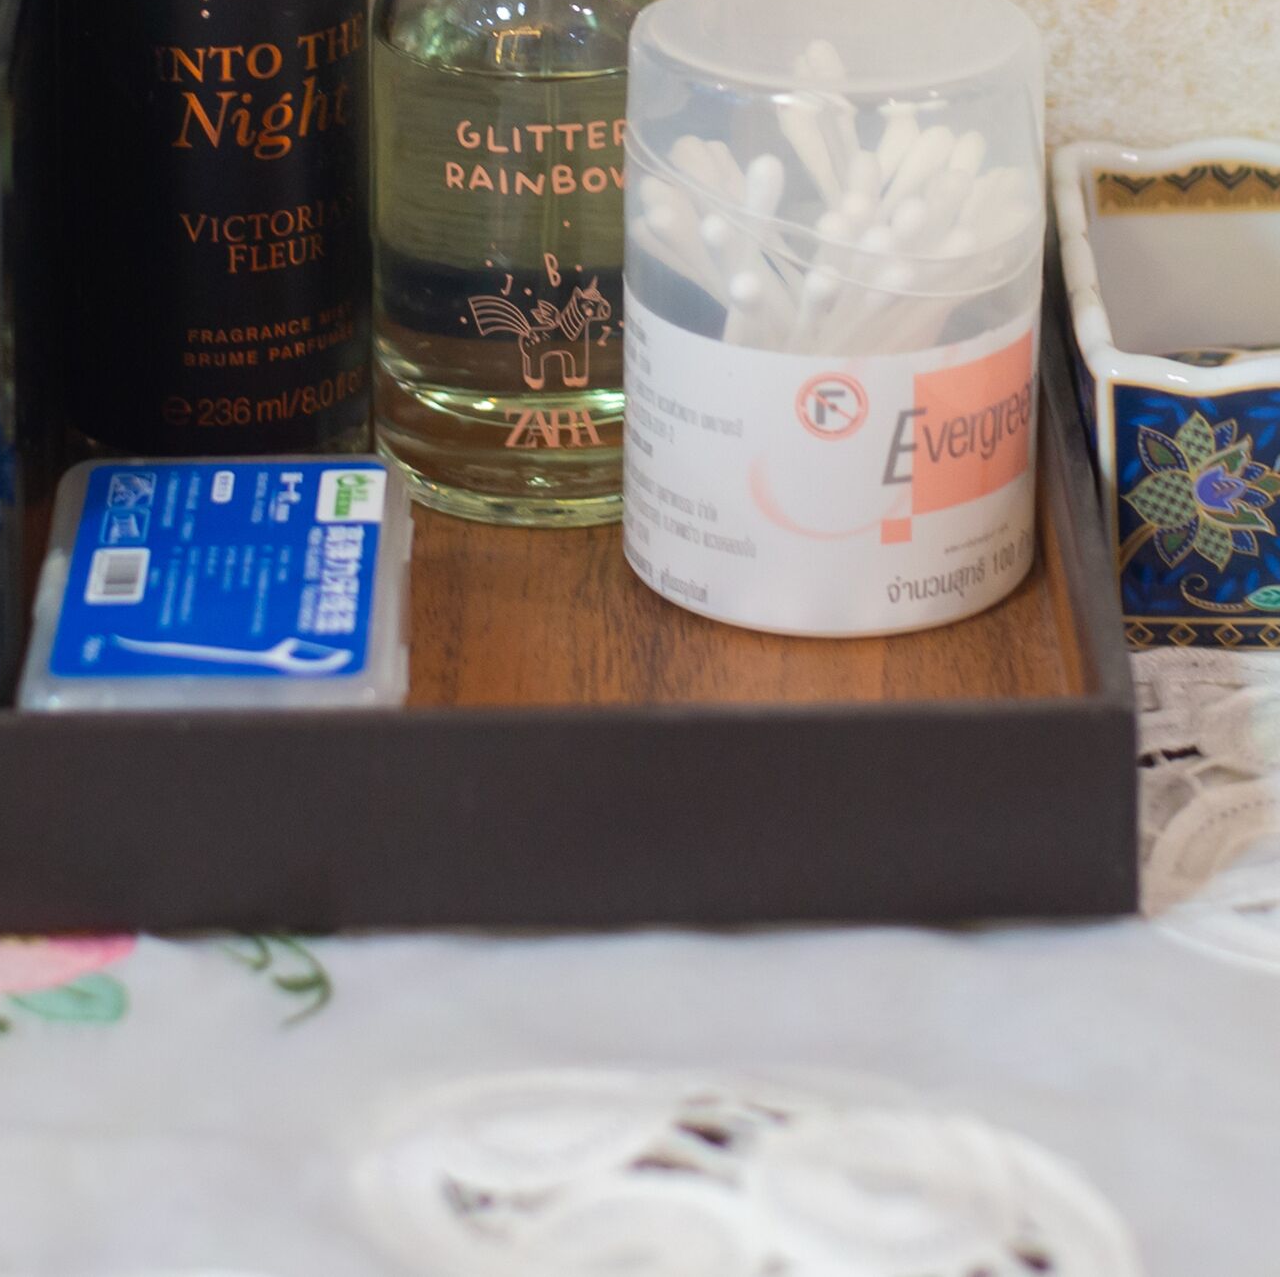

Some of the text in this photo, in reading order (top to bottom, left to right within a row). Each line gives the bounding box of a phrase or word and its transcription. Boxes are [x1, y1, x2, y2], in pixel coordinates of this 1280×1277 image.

[171, 75, 350, 161] Night
[227, 233, 325, 274] FLEUR
[186, 315, 312, 345] FRAGRANCE
[183, 349, 259, 367] BRUME
[196, 395, 251, 427] 236
[504, 408, 602, 448] ZARA
